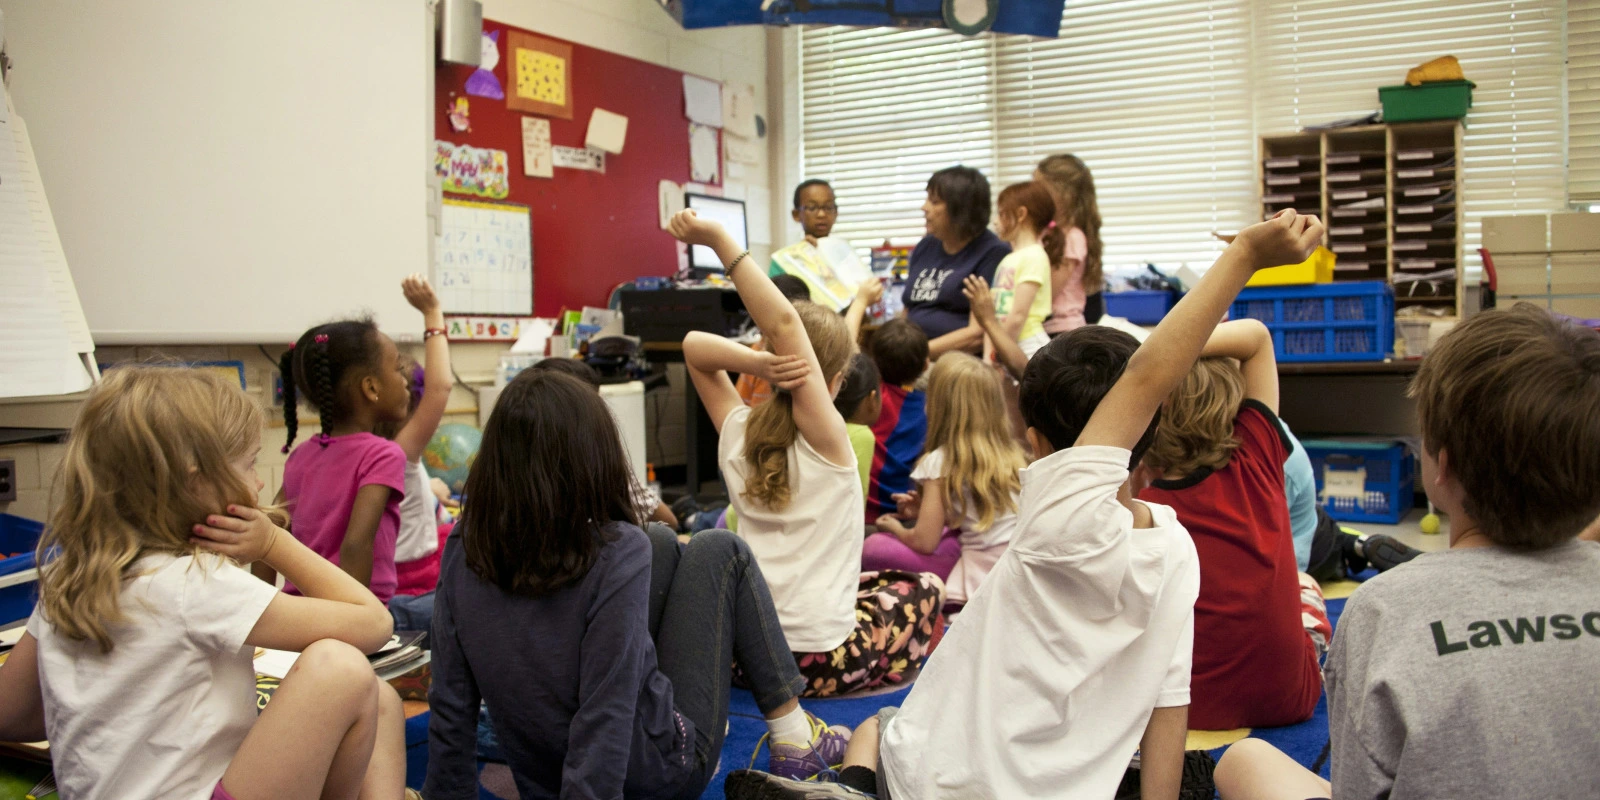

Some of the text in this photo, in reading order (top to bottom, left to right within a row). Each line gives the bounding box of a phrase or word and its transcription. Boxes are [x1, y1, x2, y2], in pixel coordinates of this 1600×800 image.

[450, 322, 510, 335] A B C
